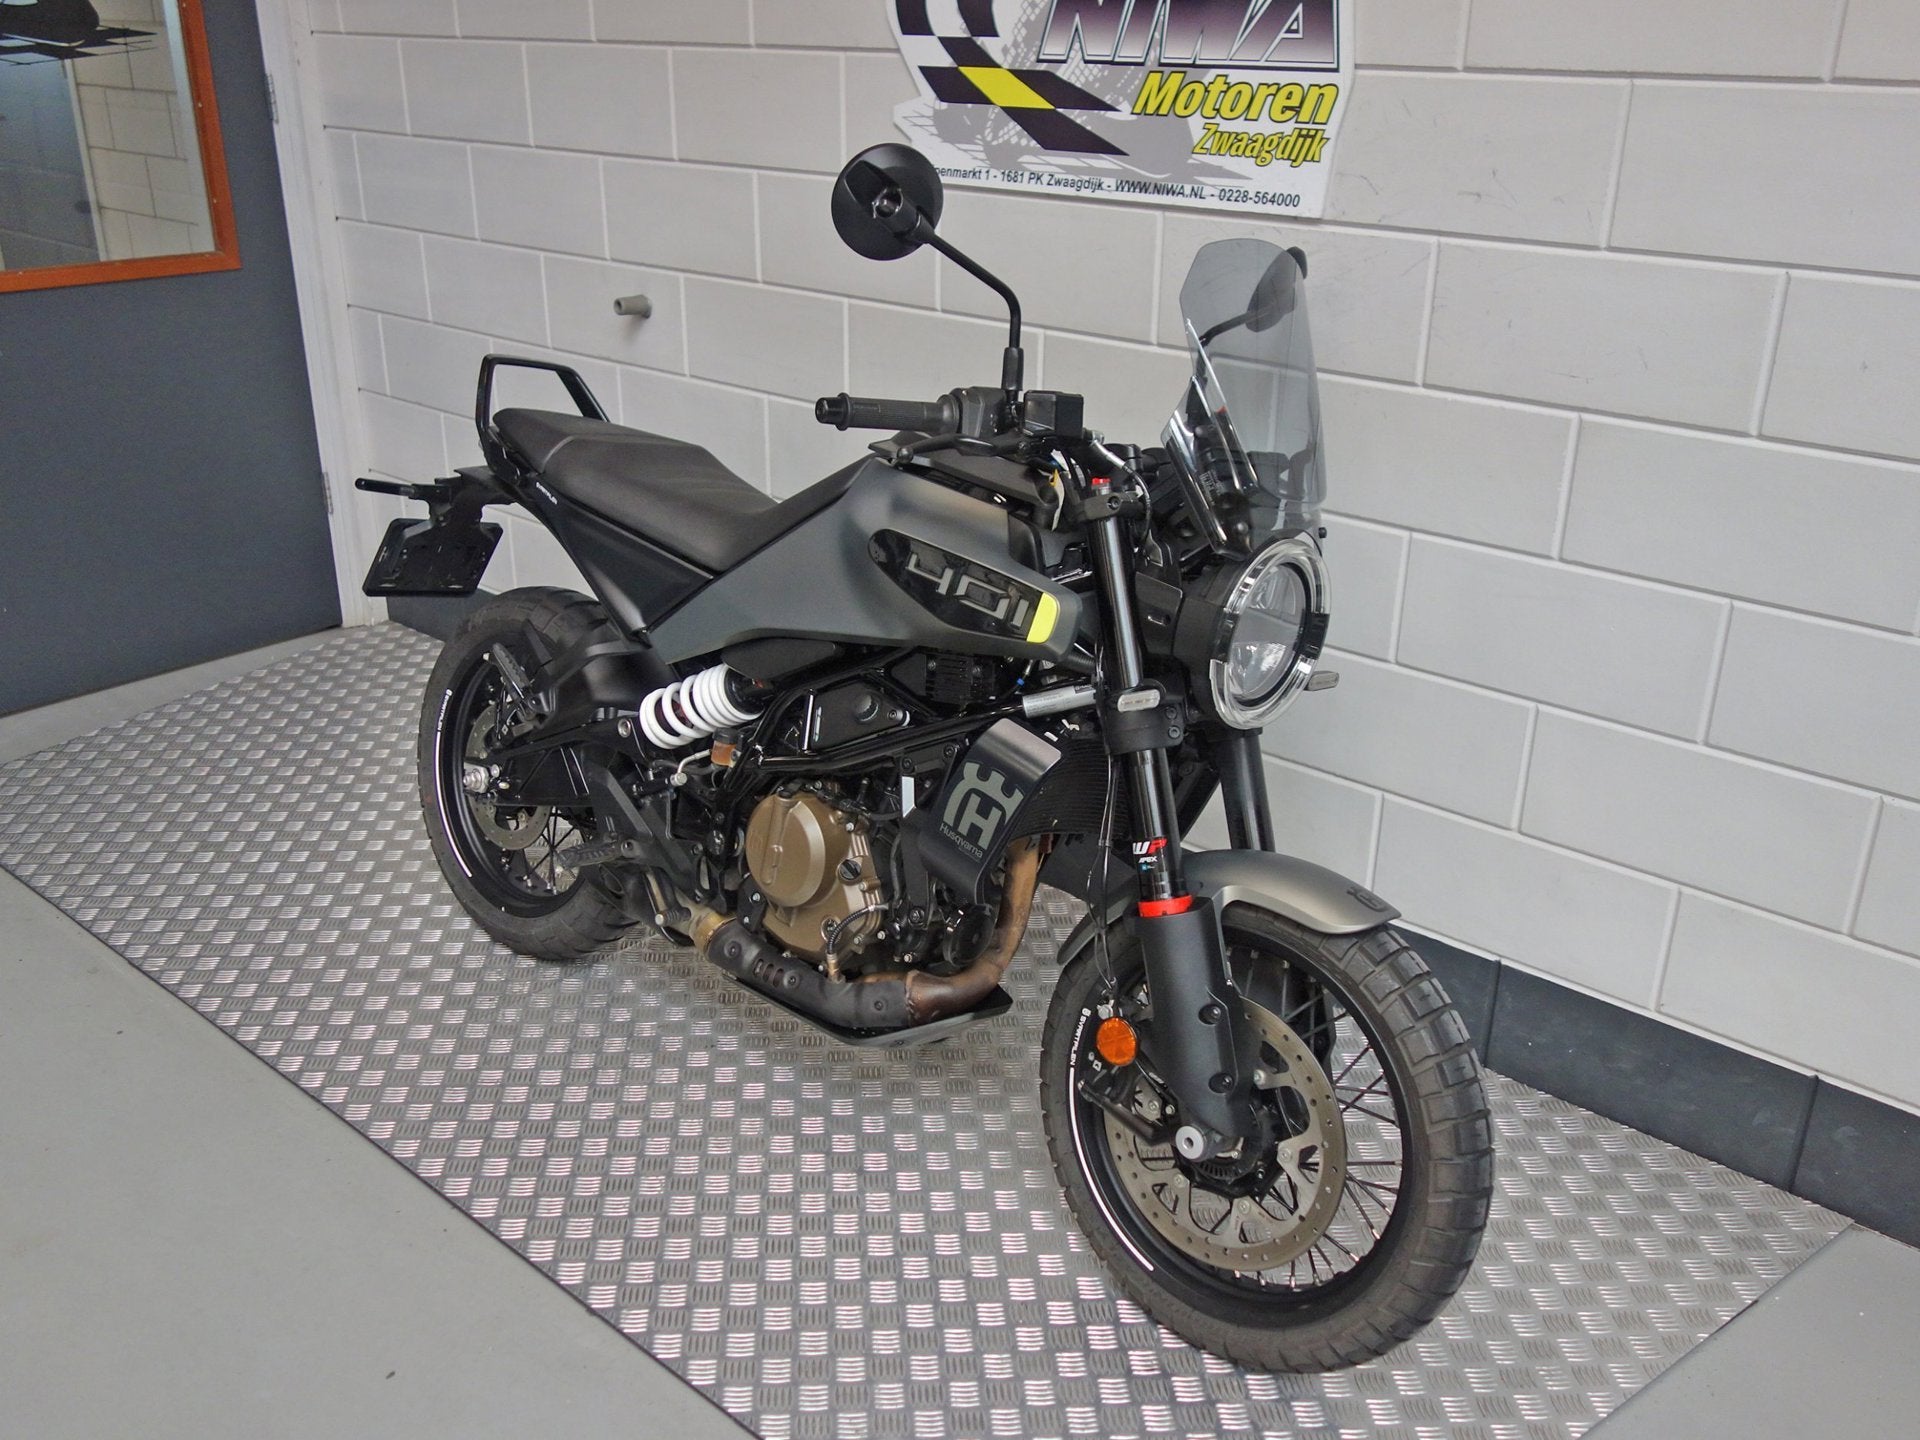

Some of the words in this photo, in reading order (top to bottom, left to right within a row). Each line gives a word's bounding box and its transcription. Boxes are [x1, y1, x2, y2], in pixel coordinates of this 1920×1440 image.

[1131, 70, 1340, 125] Motoren
[1192, 122, 1330, 168] Zwaagdijk
[985, 168, 990, 181] 1
[1001, 170, 1025, 184] 1681
[1028, 172, 1047, 186] PK
[1047, 174, 1105, 193] Zwaagdijk
[1115, 179, 1206, 200] WWW.NIWA.NL
[1218, 188, 1301, 208] 0228-564000
[939, 822, 984, 859] Husqvarna
